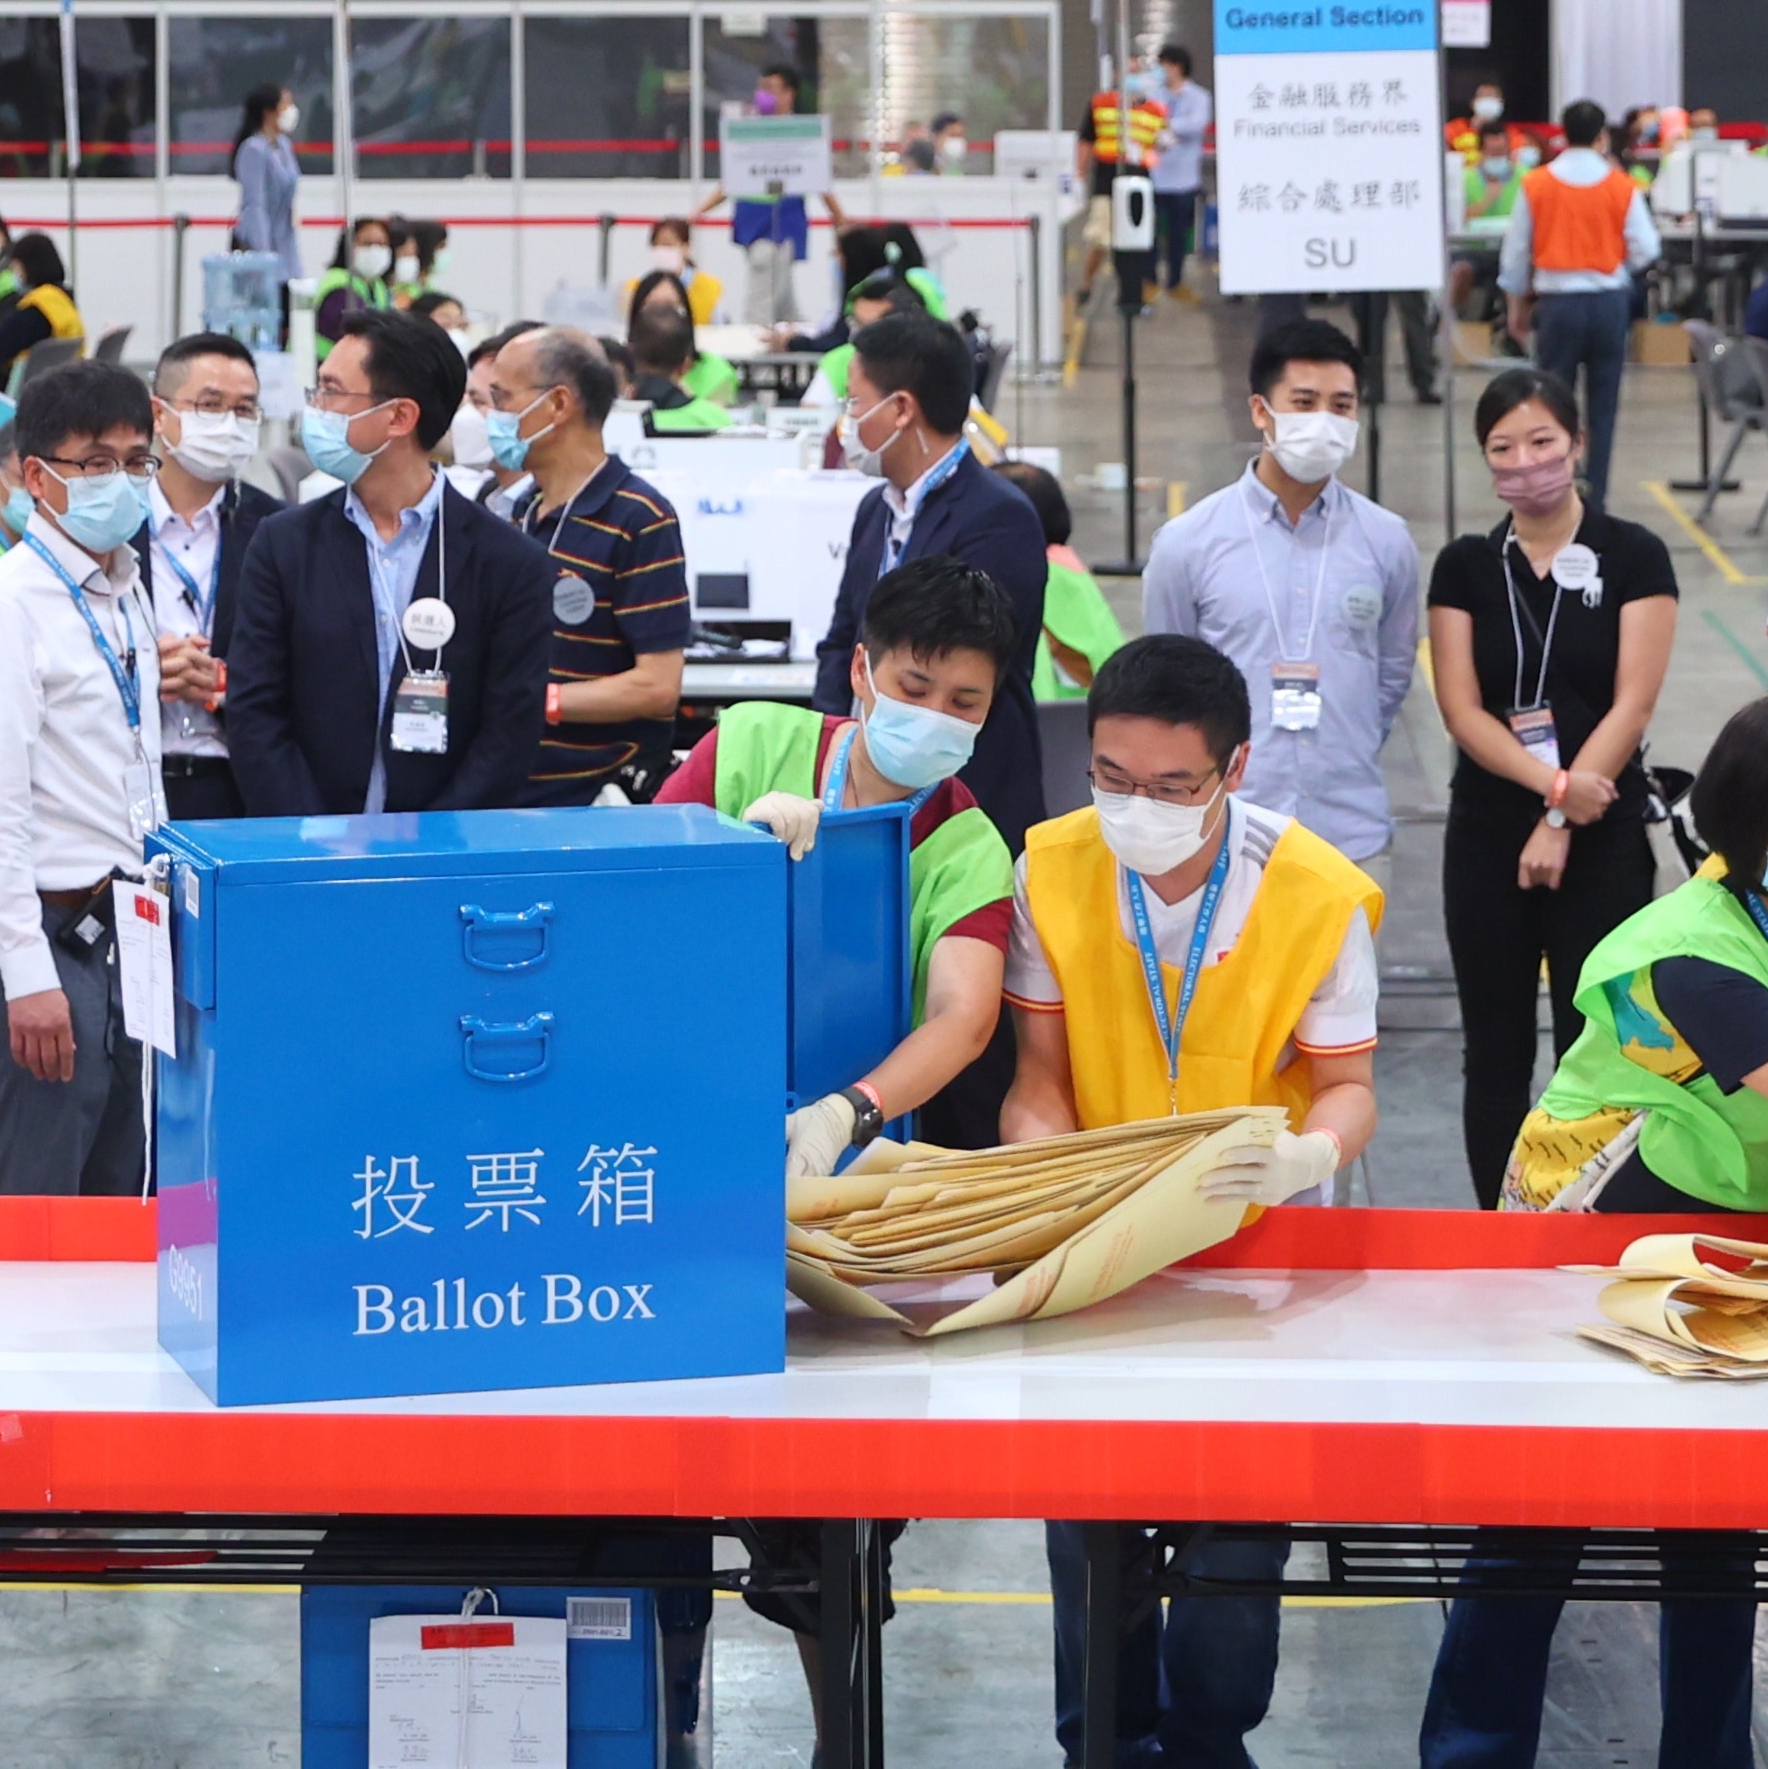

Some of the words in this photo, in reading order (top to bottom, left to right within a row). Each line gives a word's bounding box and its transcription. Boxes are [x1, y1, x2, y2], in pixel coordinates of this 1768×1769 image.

[1225, 6, 1322, 30] General
[1330, 4, 1425, 28] Section
[1248, 78, 1409, 110] 金融服務界
[1233, 118, 1325, 138] Financial
[1333, 115, 1420, 136] Services
[1237, 179, 1420, 214] 綜合處理部
[1304, 237, 1357, 269] SU
[1181, 946, 1202, 1004] ELECTORAL
[351, 1142, 659, 1240] 投票箱
[168, 1242, 203, 1322] G9951
[351, 1276, 526, 1336] Ballot
[541, 1272, 656, 1326] Box
